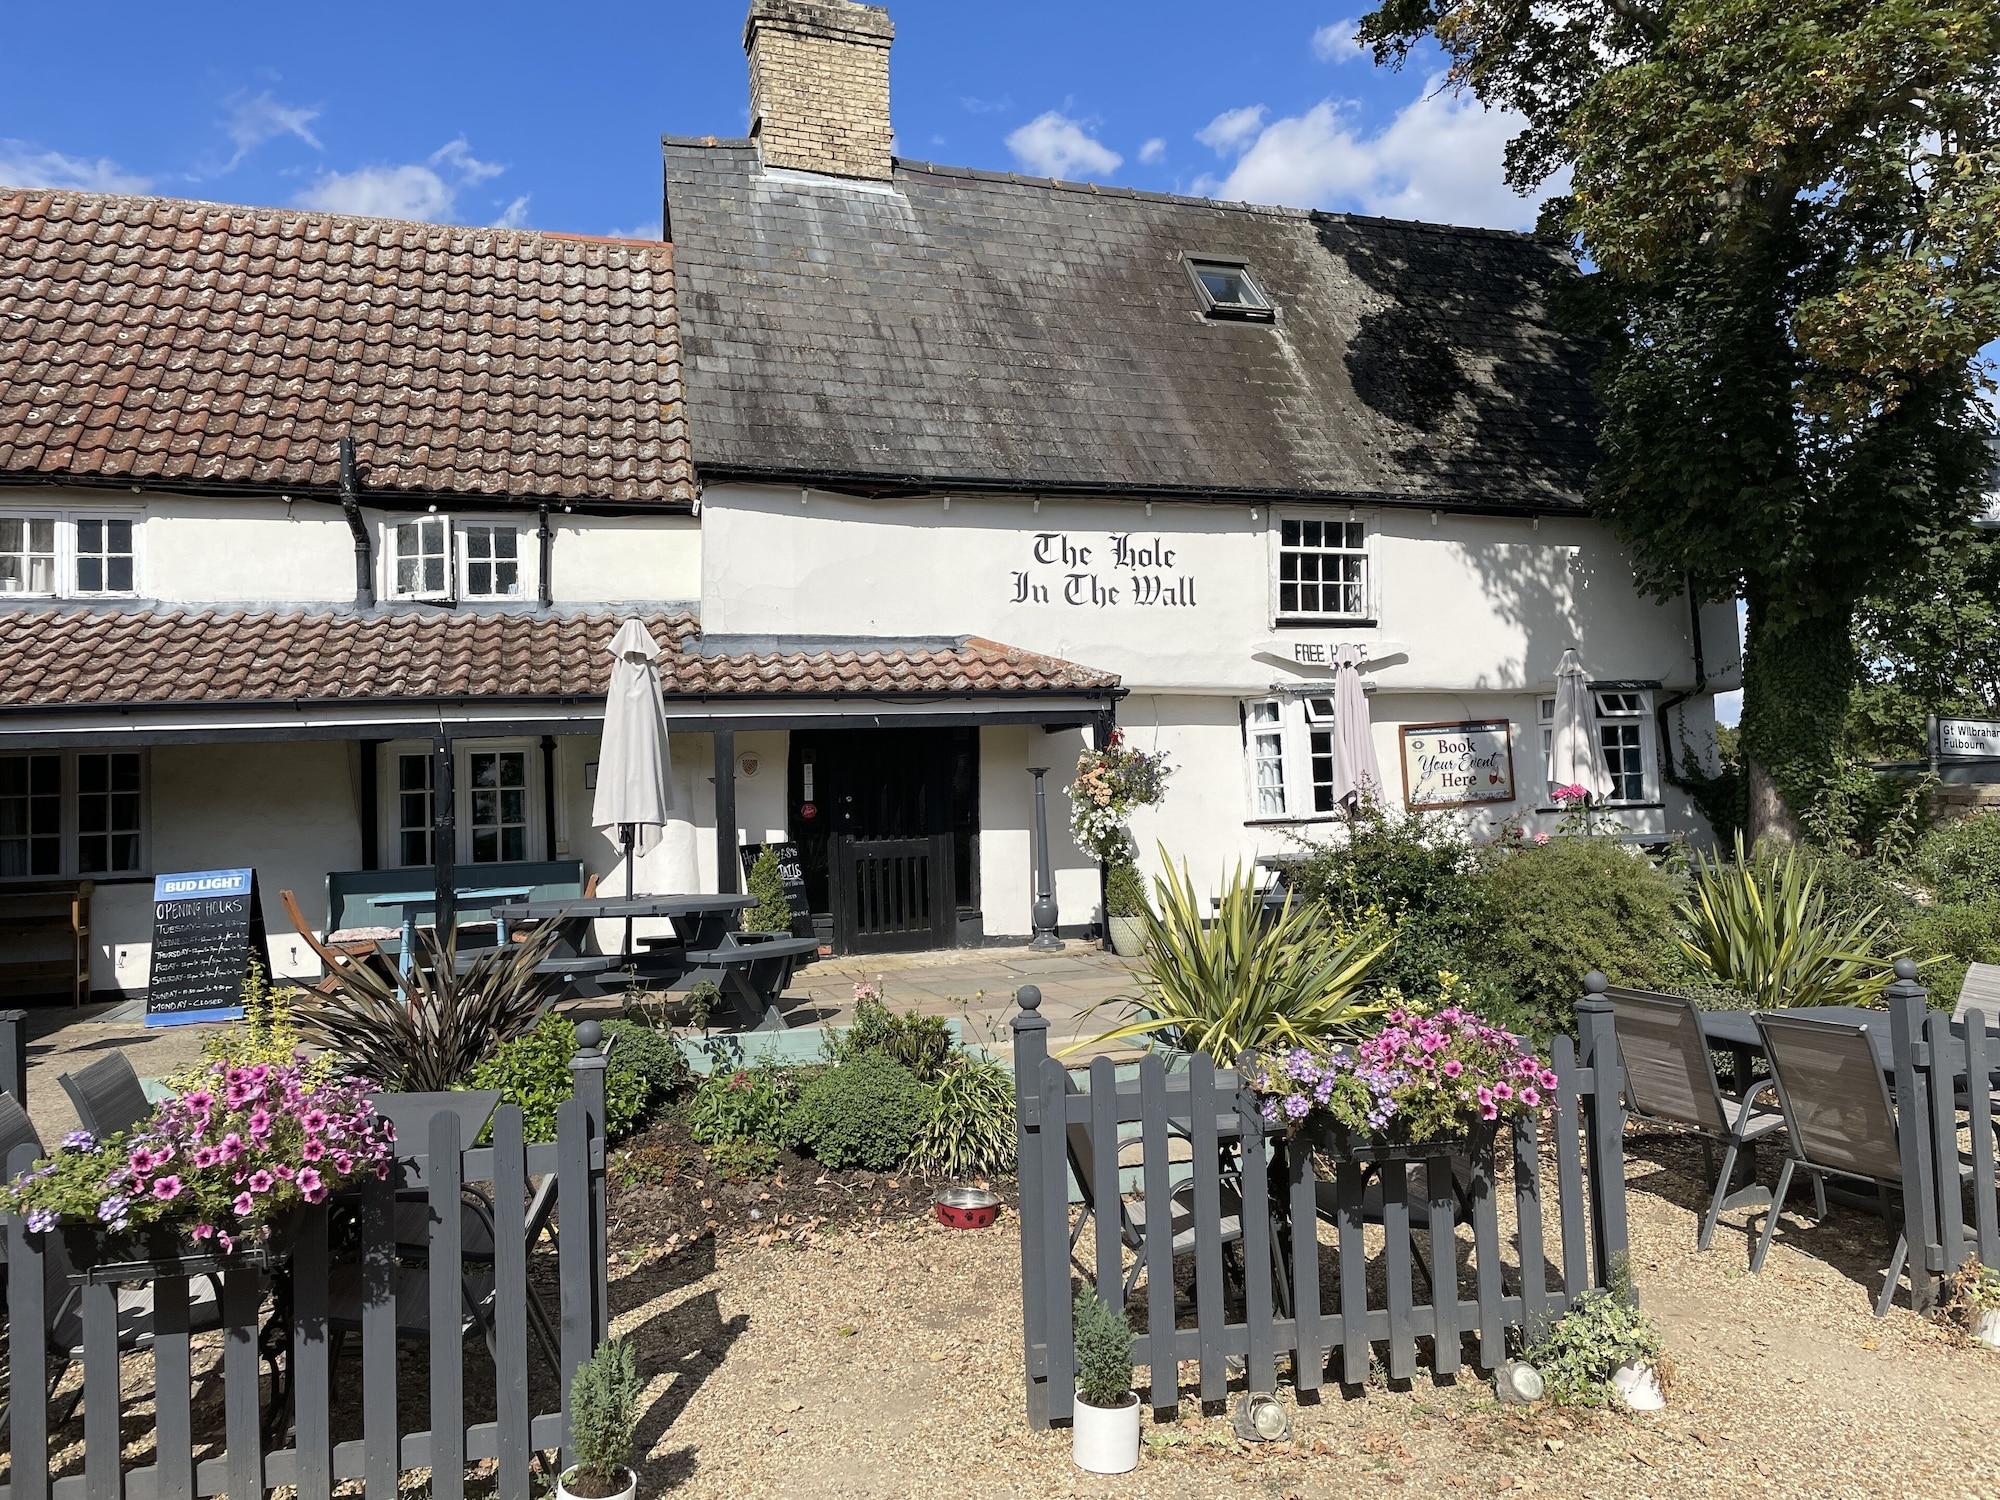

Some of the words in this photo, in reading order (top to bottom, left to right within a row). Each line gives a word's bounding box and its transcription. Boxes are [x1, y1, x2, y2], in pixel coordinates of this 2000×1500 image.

[1033, 533, 1092, 569] The
[1108, 533, 1176, 571] Hole
[1009, 571, 1050, 604] In
[1064, 573, 1120, 609] The
[1131, 575, 1197, 607] Wall
[1295, 643, 1325, 662] FREE
[1943, 725, 1954, 735] Gt
[1438, 737, 1477, 754] Book
[1943, 738, 1985, 749] Fulbourn
[1418, 755, 1456, 780] Your
[1458, 752, 1504, 771] Event
[1441, 772, 1477, 787] Here
[165, 880, 197, 892] BUD
[198, 876, 242, 890] LIGHT
[156, 902, 200, 920] OPENING
[206, 899, 242, 917] HOURS
[151, 1000, 187, 1012] MONDAY
[193, 998, 223, 1006] CLOSED
